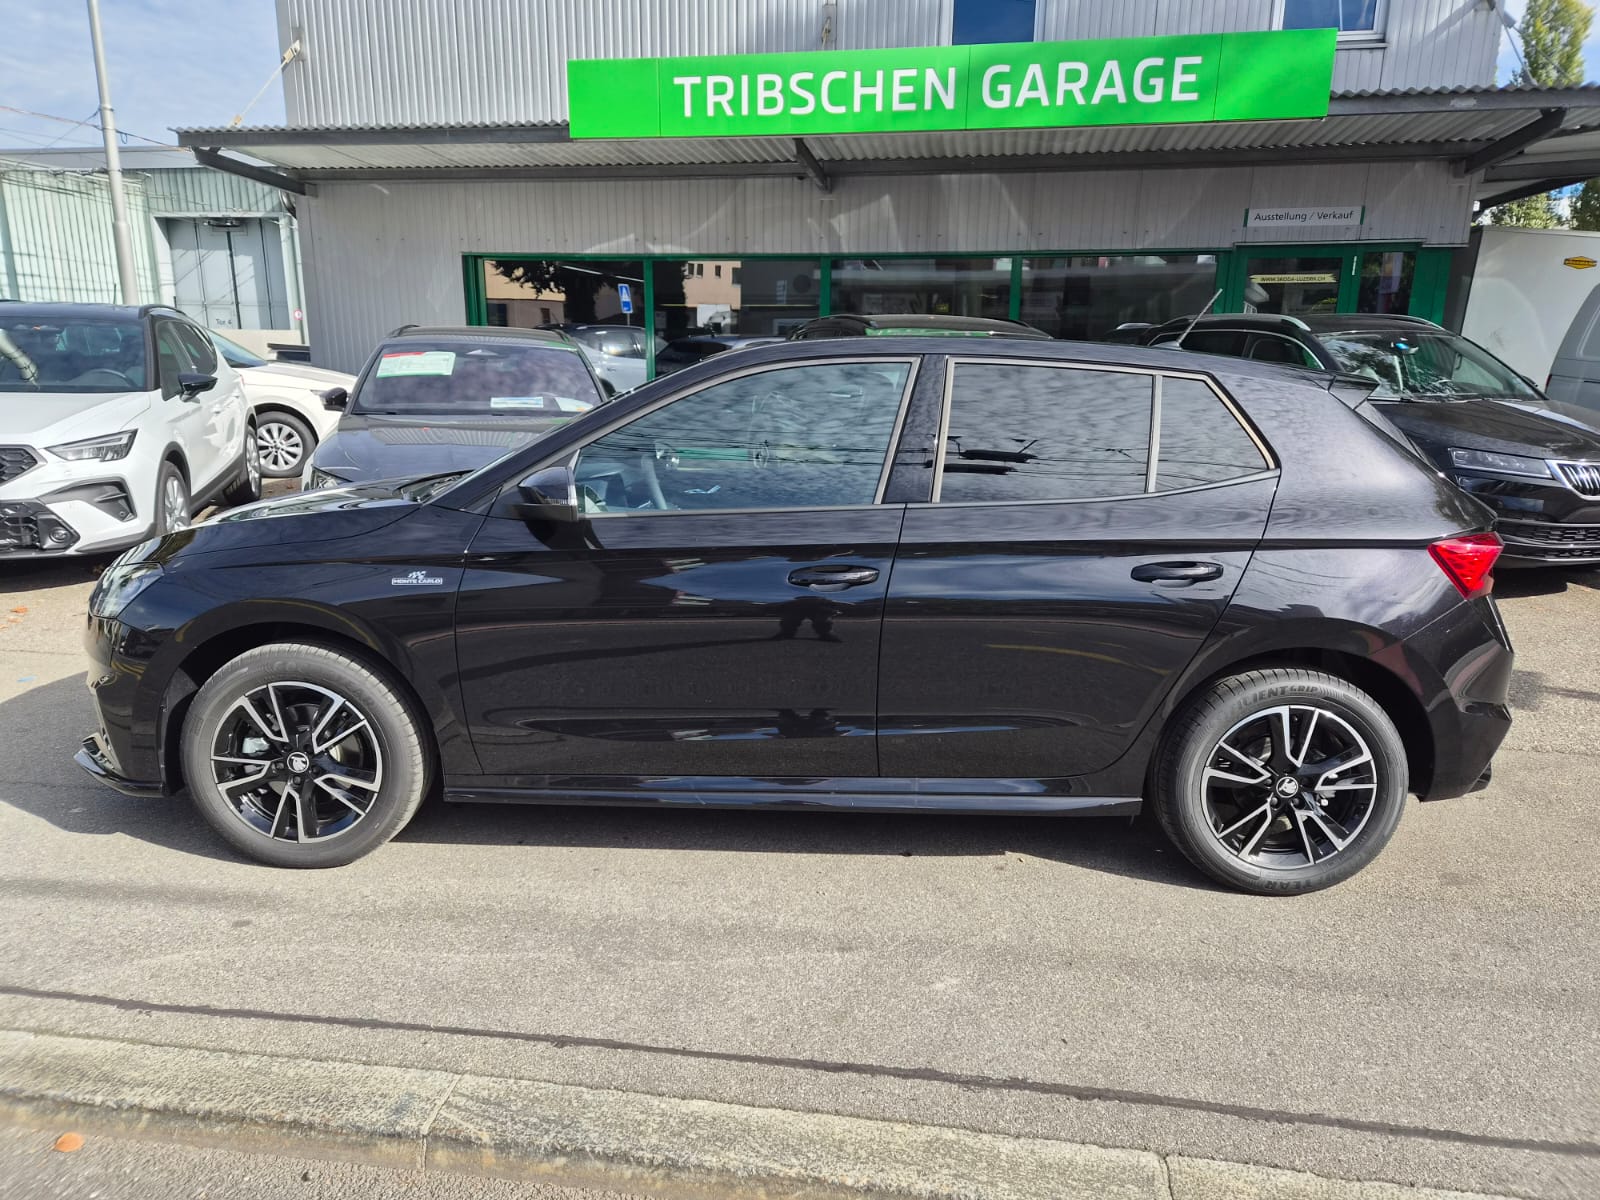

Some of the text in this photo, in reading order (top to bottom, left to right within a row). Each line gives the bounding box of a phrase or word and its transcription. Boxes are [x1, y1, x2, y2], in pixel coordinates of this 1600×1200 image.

[673, 56, 1203, 118] TRIBSCHEN GARAGE
[1254, 210, 1354, 222] Ausstellung / Verkauf
